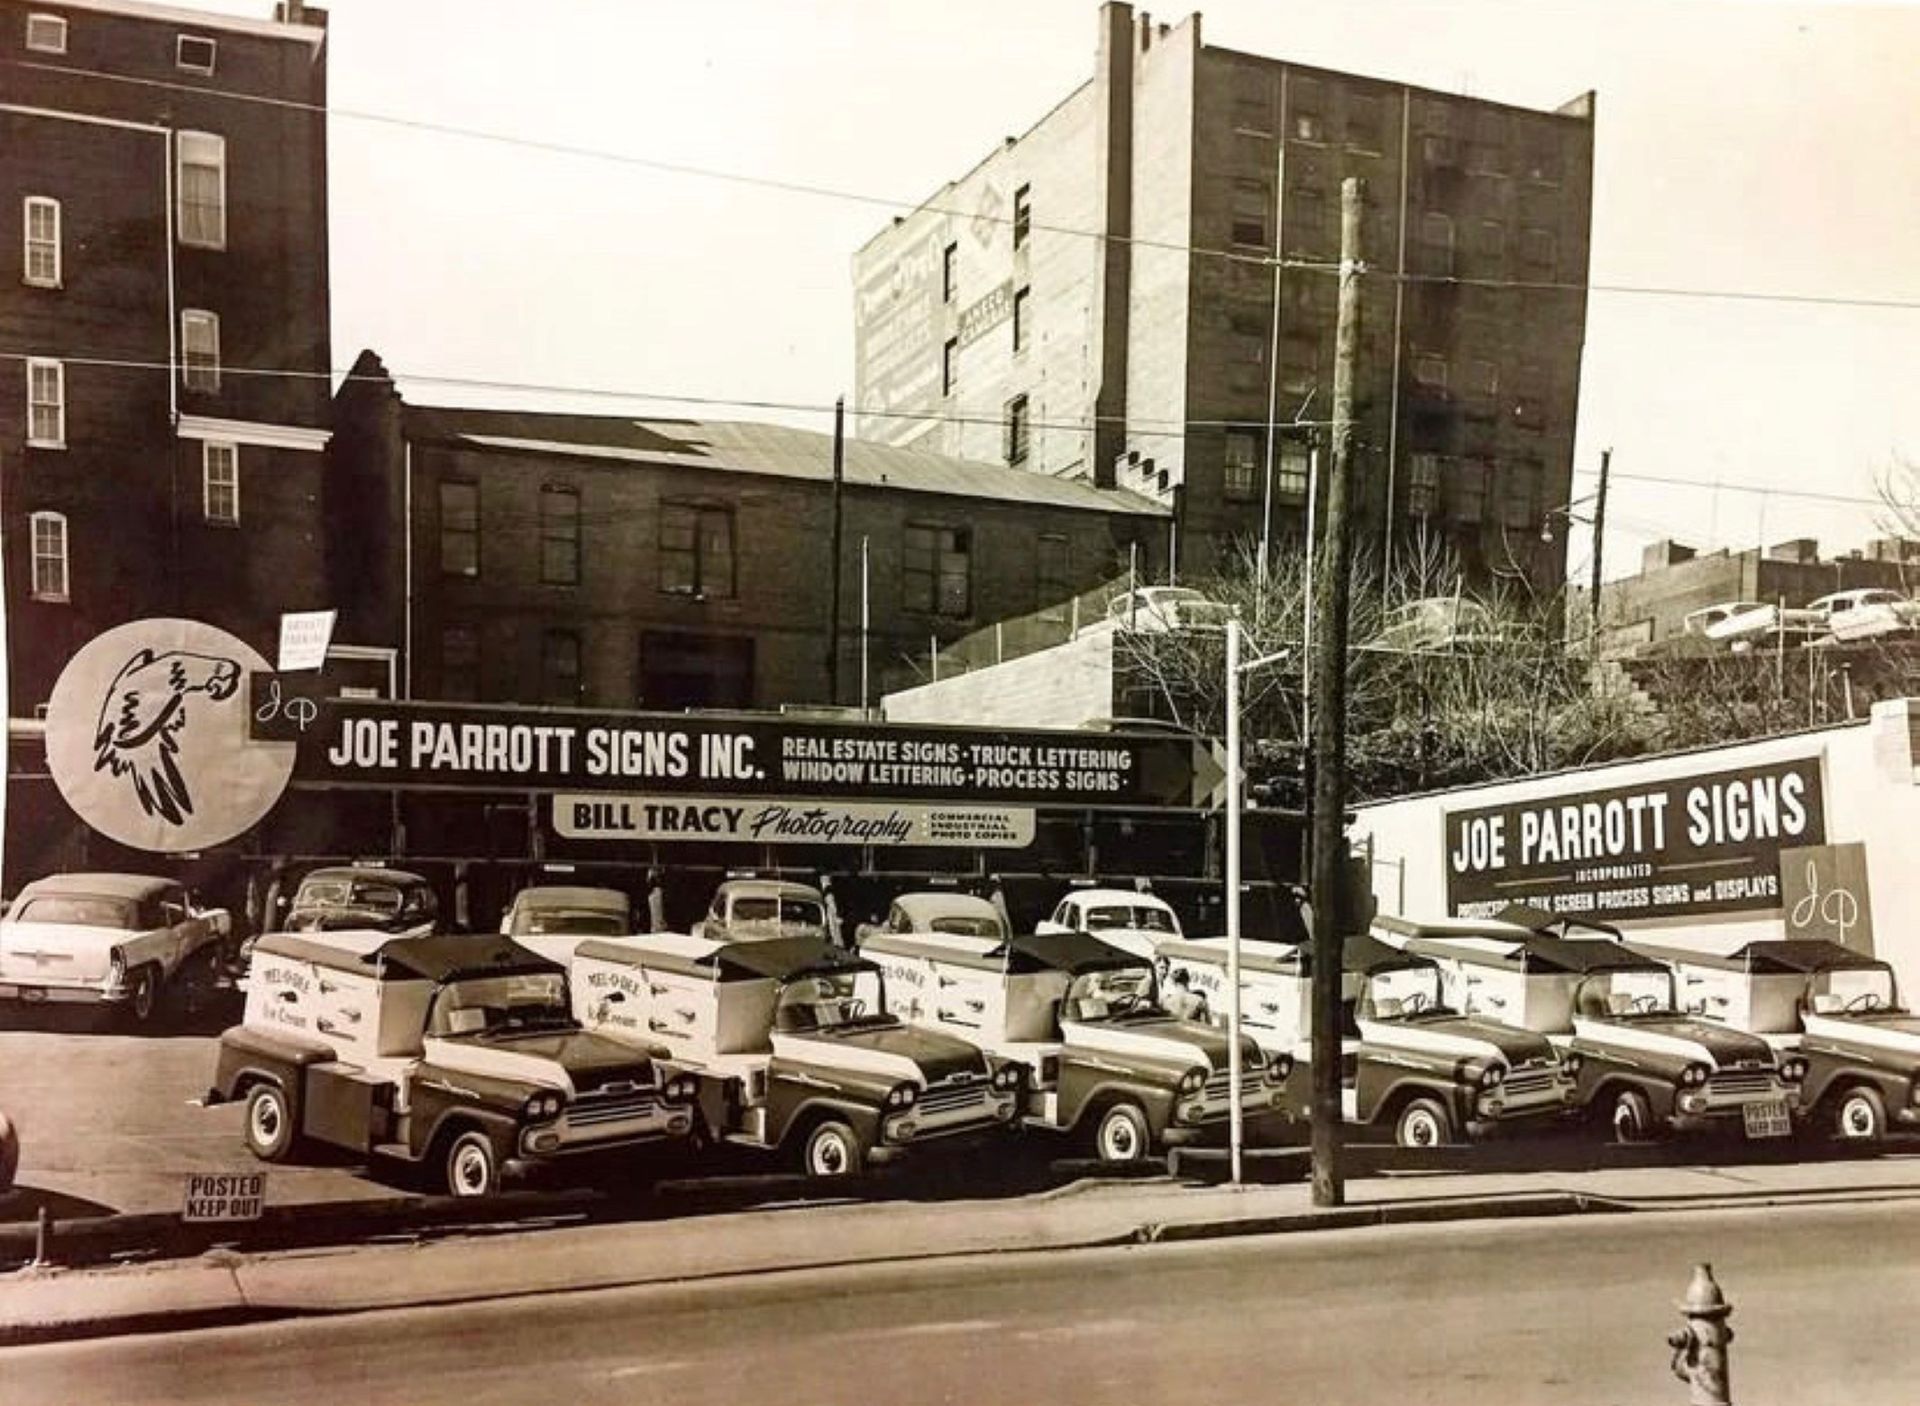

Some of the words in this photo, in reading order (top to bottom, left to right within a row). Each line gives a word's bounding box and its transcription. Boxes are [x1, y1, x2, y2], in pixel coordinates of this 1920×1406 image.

[329, 719, 399, 768] JOE
[411, 721, 576, 774] PARROTT
[587, 729, 689, 777] SIGNS
[700, 733, 766, 780] INC.
[834, 739, 897, 761] ESTATE
[901, 742, 959, 763] SIGNS
[970, 745, 1032, 766] TRUCK
[1038, 747, 1132, 770] LETTERING
[783, 760, 864, 783] WINDOW
[869, 762, 965, 786] LETTERING
[976, 768, 1060, 789] PROCESS
[1065, 771, 1119, 791] SIGNS
[573, 803, 636, 831] BILL
[645, 804, 745, 834] TRACY
[750, 806, 914, 843] Photography
[931, 812, 1009, 822] COMMERCIAL
[931, 822, 1007, 830] INDUSTRIAL
[1453, 815, 1506, 873] JOE
[1521, 792, 1669, 866] PARROTT
[1686, 772, 1807, 847] SIGNS
[931, 831, 972, 839] PHOTO
[975, 831, 1018, 840] COPIES
[1575, 863, 1652, 883] INCORPORATED
[1554, 892, 1595, 912] SCREEN
[1597, 887, 1649, 909] PROCESS
[1652, 883, 1690, 905] SIGNS
[1693, 885, 1712, 902] and
[1714, 875, 1778, 901] DISPLAYS
[191, 1176, 261, 1197] POSTED
[187, 1199, 227, 1217] KEEP
[230, 1198, 259, 1217] OUT
